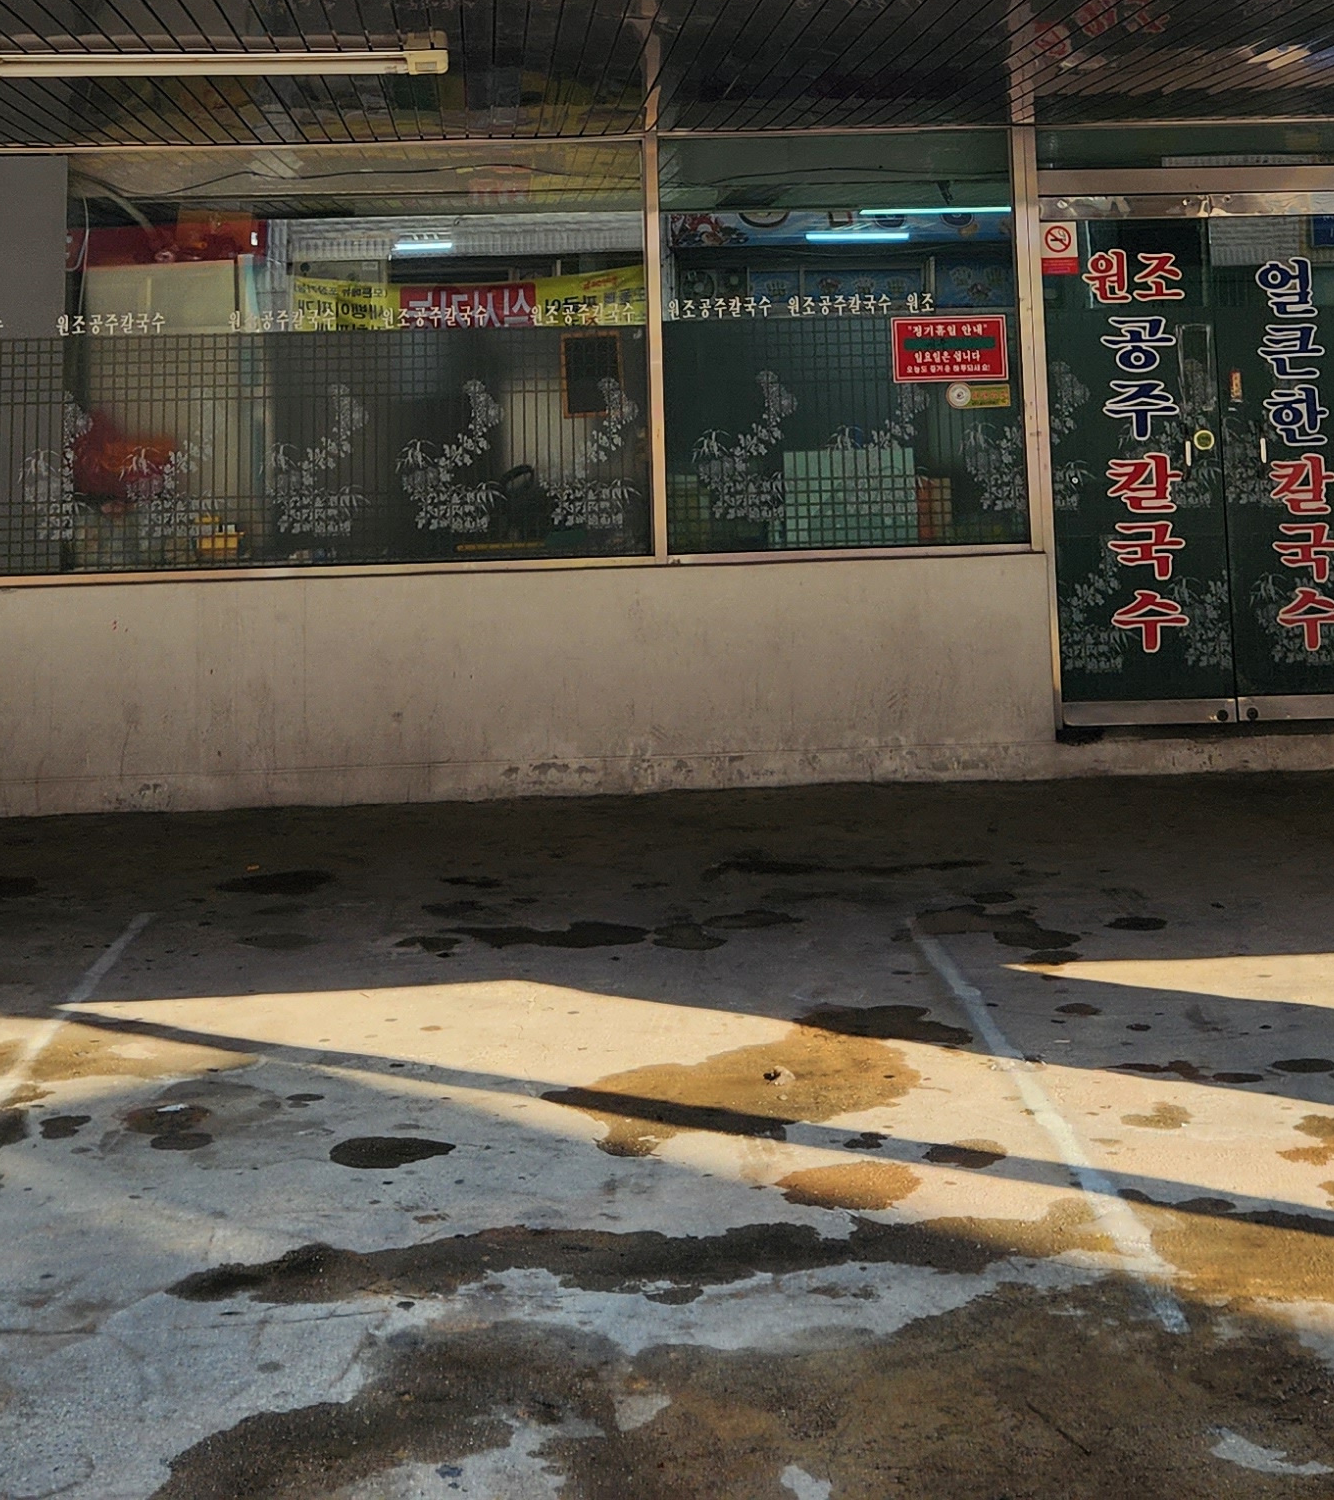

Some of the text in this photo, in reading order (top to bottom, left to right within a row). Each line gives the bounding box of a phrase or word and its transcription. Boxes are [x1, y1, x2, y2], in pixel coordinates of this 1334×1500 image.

[1082, 249, 1186, 304] 원조
[905, 292, 935, 314] 원조
[914, 351, 951, 364] 일요일은
